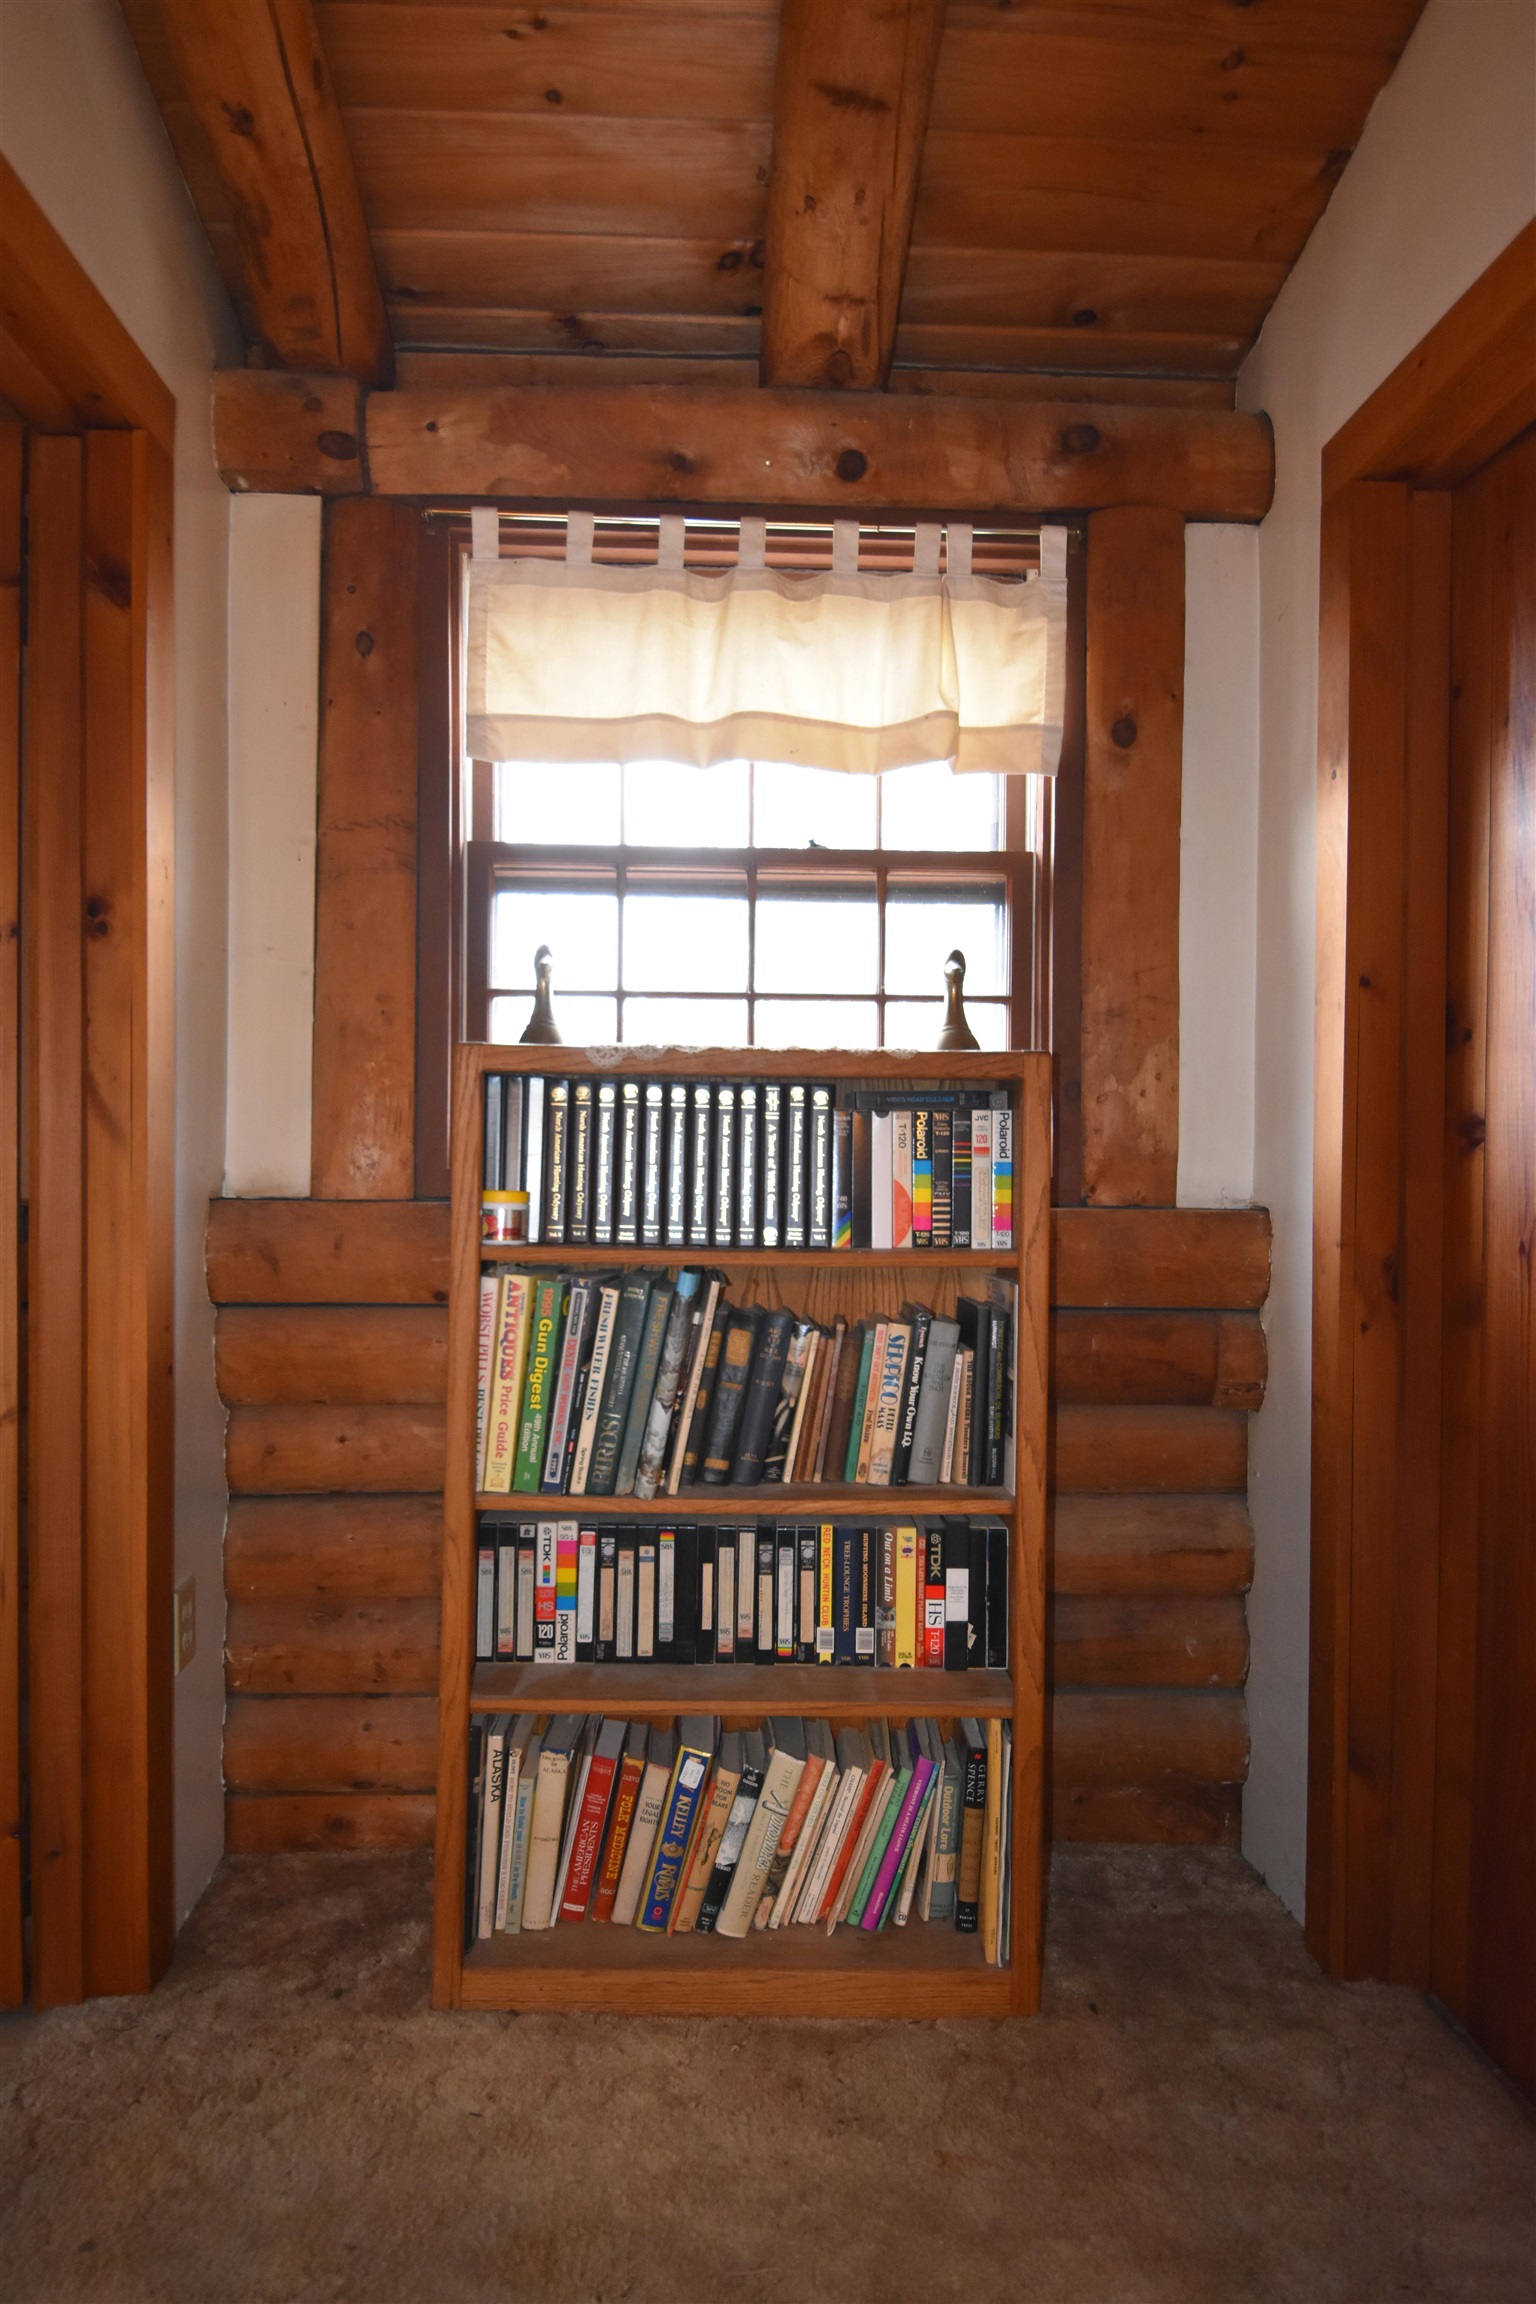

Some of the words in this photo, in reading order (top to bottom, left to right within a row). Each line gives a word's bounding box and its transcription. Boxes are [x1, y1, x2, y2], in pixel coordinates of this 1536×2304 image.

[555, 1111, 563, 1132] North
[579, 1110, 587, 1131] North
[768, 1124, 776, 1132] A
[554, 1132, 562, 1164] American
[578, 1131, 586, 1163] American
[768, 1133, 776, 1156] Taste
[916, 1111, 928, 1159] Polaroid
[976, 1134, 988, 1144] 120
[999, 1112, 1009, 1159] Polaroid
[576, 1163, 585, 1191] Hunting
[768, 1157, 776, 1169] of
[552, 1164, 561, 1192] Hunting
[767, 1169, 775, 1192] Wild
[551, 1192, 561, 1221] Odyssey
[575, 1191, 585, 1219] Odyssey
[766, 1194, 775, 1219] Game
[934, 1237, 949, 1245] VHS
[953, 1236, 969, 1244] VHS
[478, 1291, 493, 1338] WORST
[540, 1286, 554, 1316] 1995
[497, 1278, 523, 1380] ANTIQUES
[536, 1317, 553, 1353] Gun
[526, 1355, 548, 1410] Digest
[879, 1332, 906, 1406] SERPICO
[910, 1355, 923, 1384] Know
[498, 1384, 513, 1415] Price
[583, 1378, 599, 1421] FISHES
[907, 1384, 919, 1406] Your
[532, 1412, 542, 1431] 49th
[876, 1406, 886, 1429] MAAS
[885, 1407, 896, 1432] PETER
[903, 1406, 916, 1430] Own
[495, 1421, 510, 1459] Guide
[521, 1422, 532, 1452] Edition
[528, 1432, 540, 1463] Annual
[591, 1417, 621, 1485] BIRDS
[578, 1446, 587, 1464] Spring
[960, 1451, 968, 1479] Roosevelt
[575, 1466, 584, 1484] Books
[543, 1536, 551, 1562] TDK
[823, 1527, 831, 1543] RED
[884, 1532, 894, 1552] Out
[823, 1547, 831, 1569] NECK
[843, 1540, 851, 1593] TREE-LOUNGE
[884, 1553, 892, 1565] on
[930, 1544, 941, 1578] TDK
[822, 1573, 830, 1603] HUNTIN
[884, 1576, 893, 1602] Limb
[538, 1601, 554, 1611] HS
[821, 1605, 830, 1626] CLUB
[842, 1596, 851, 1632] TROPHIES
[928, 1603, 942, 1626] HS
[537, 1624, 554, 1639] 120
[557, 1614, 569, 1660] Polaroid
[930, 1630, 940, 1655] T-120
[490, 1749, 502, 1802] ALASKA
[778, 1767, 793, 1791] THE
[965, 1763, 975, 1802] SPENCE
[976, 1764, 986, 1803] GERRY
[712, 1800, 728, 1809] BEARS
[715, 1786, 732, 1795] ROOM
[716, 1794, 728, 1802] FOR
[616, 1794, 632, 1823] FOLK
[642, 1809, 660, 1818] LEGAL
[645, 1802, 660, 1810] YOUR
[669, 1794, 691, 1838] KELLEY
[940, 1785, 953, 1825] Outdoor
[572, 1818, 590, 1876] AMERICAN
[579, 1820, 599, 1885] PRESIDENTS
[605, 1824, 627, 1880] MEDICINE
[939, 1827, 950, 1850] Lore
[570, 1875, 579, 1892] THE
[738, 1873, 760, 1919] READER
